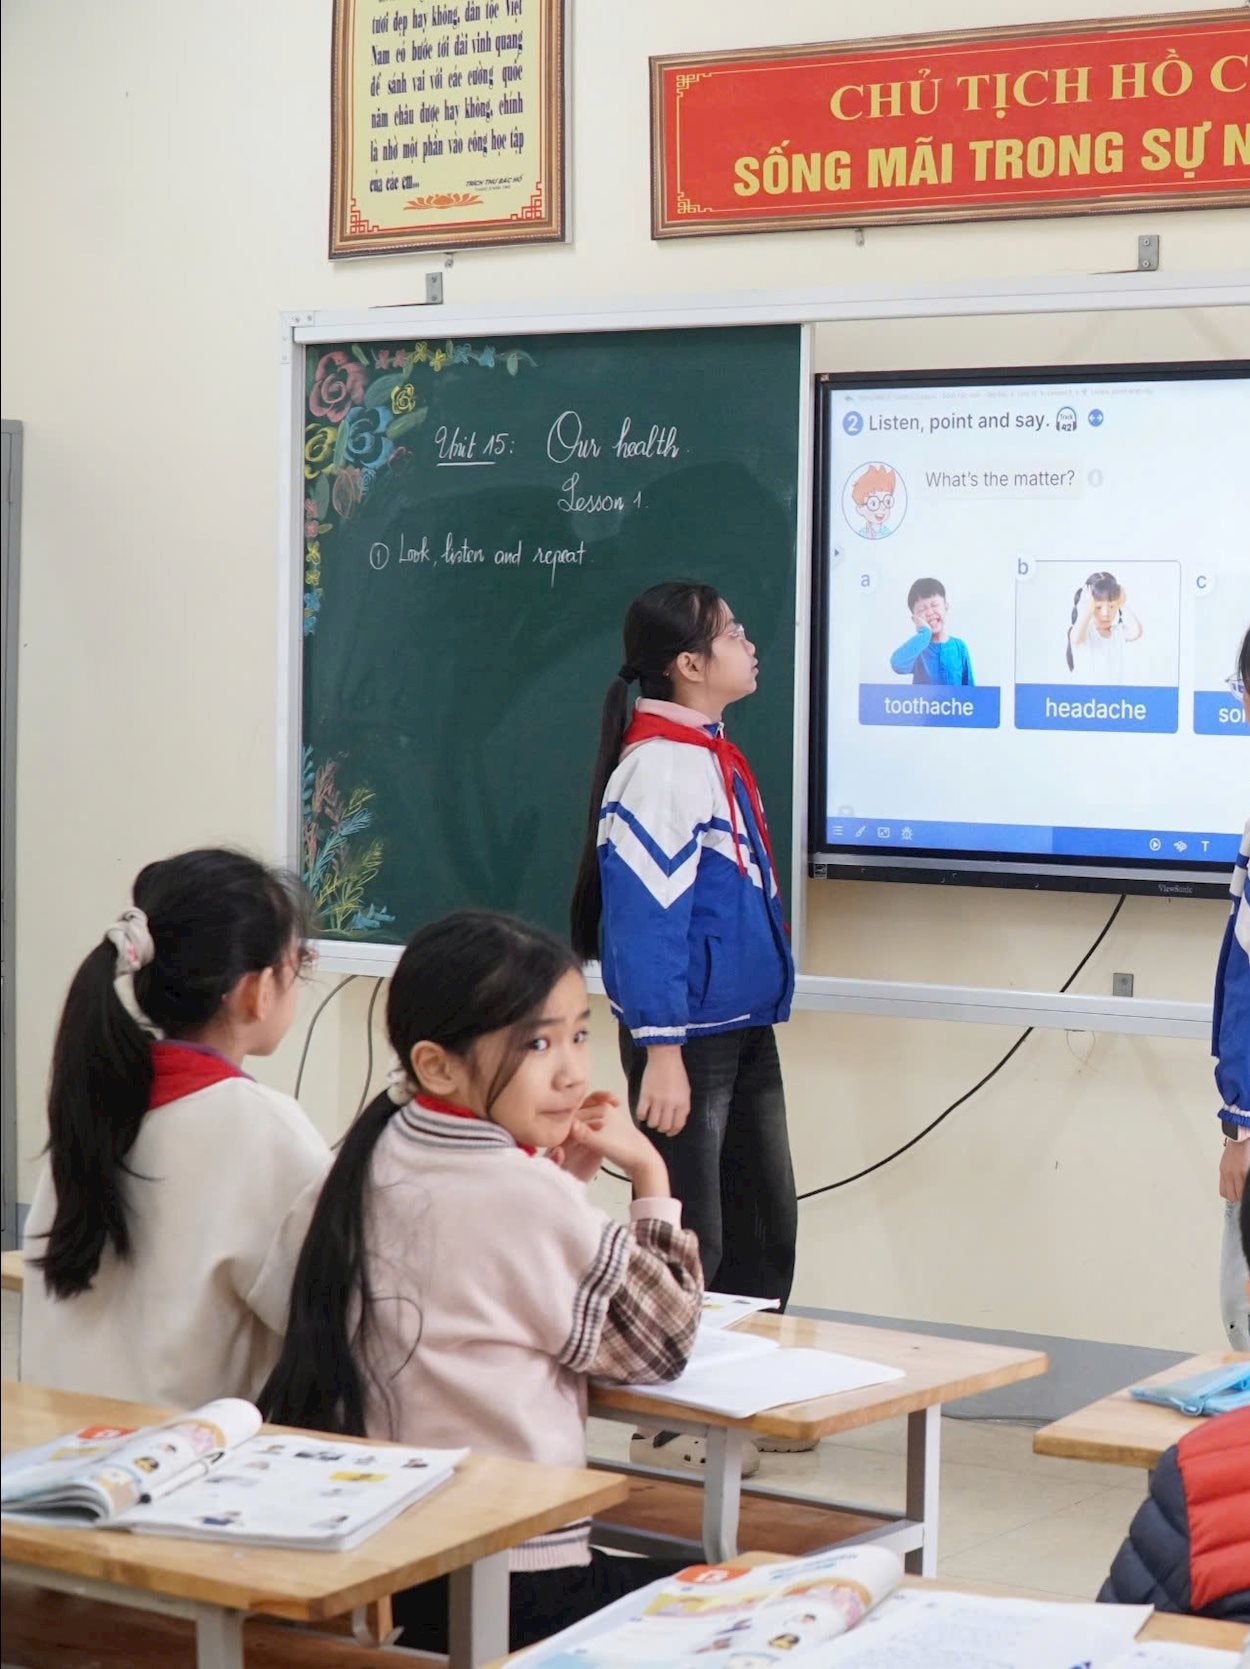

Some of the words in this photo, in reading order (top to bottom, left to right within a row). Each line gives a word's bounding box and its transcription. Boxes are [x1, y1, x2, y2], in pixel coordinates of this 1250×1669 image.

[412, 8, 427, 33] hay
[371, 45, 390, 66] Nam
[472, 31, 492, 53] vinh
[495, 31, 523, 57] quang
[388, 72, 407, 95] sánh
[412, 69, 425, 91] vai
[430, 67, 443, 89] với
[448, 65, 462, 88] các
[829, 68, 943, 122] CHỦ
[957, 67, 1093, 119] TỊCH
[1108, 48, 1194, 101] HỒ
[394, 104, 414, 126] châu
[445, 99, 459, 126] hay
[499, 91, 523, 116] chính
[370, 138, 378, 162] là
[403, 136, 418, 163] một
[448, 130, 463, 154] vào
[468, 130, 488, 157] công
[491, 128, 507, 156] học
[510, 126, 524, 155] tập
[733, 139, 851, 197] SỐNG
[867, 137, 953, 187] MÃI
[969, 131, 1124, 181] TRONG
[1141, 121, 1212, 179] SỰ
[868, 414, 924, 434] Listen,
[929, 412, 973, 434] point
[978, 411, 1009, 429] and
[1015, 413, 1050, 430] say.
[435, 425, 476, 459] Unit
[547, 410, 601, 463] Our
[983, 470, 1009, 487] the
[1014, 469, 1076, 487] matter?
[557, 472, 624, 513] Lesson
[441, 532, 484, 565] listen
[494, 540, 522, 566] and
[1017, 558, 1029, 576] b
[861, 574, 870, 588] a
[1196, 575, 1207, 589] c
[884, 697, 974, 717] toothache
[1046, 697, 1147, 721] headache
[1158, 883, 1193, 894] ViewSonic
